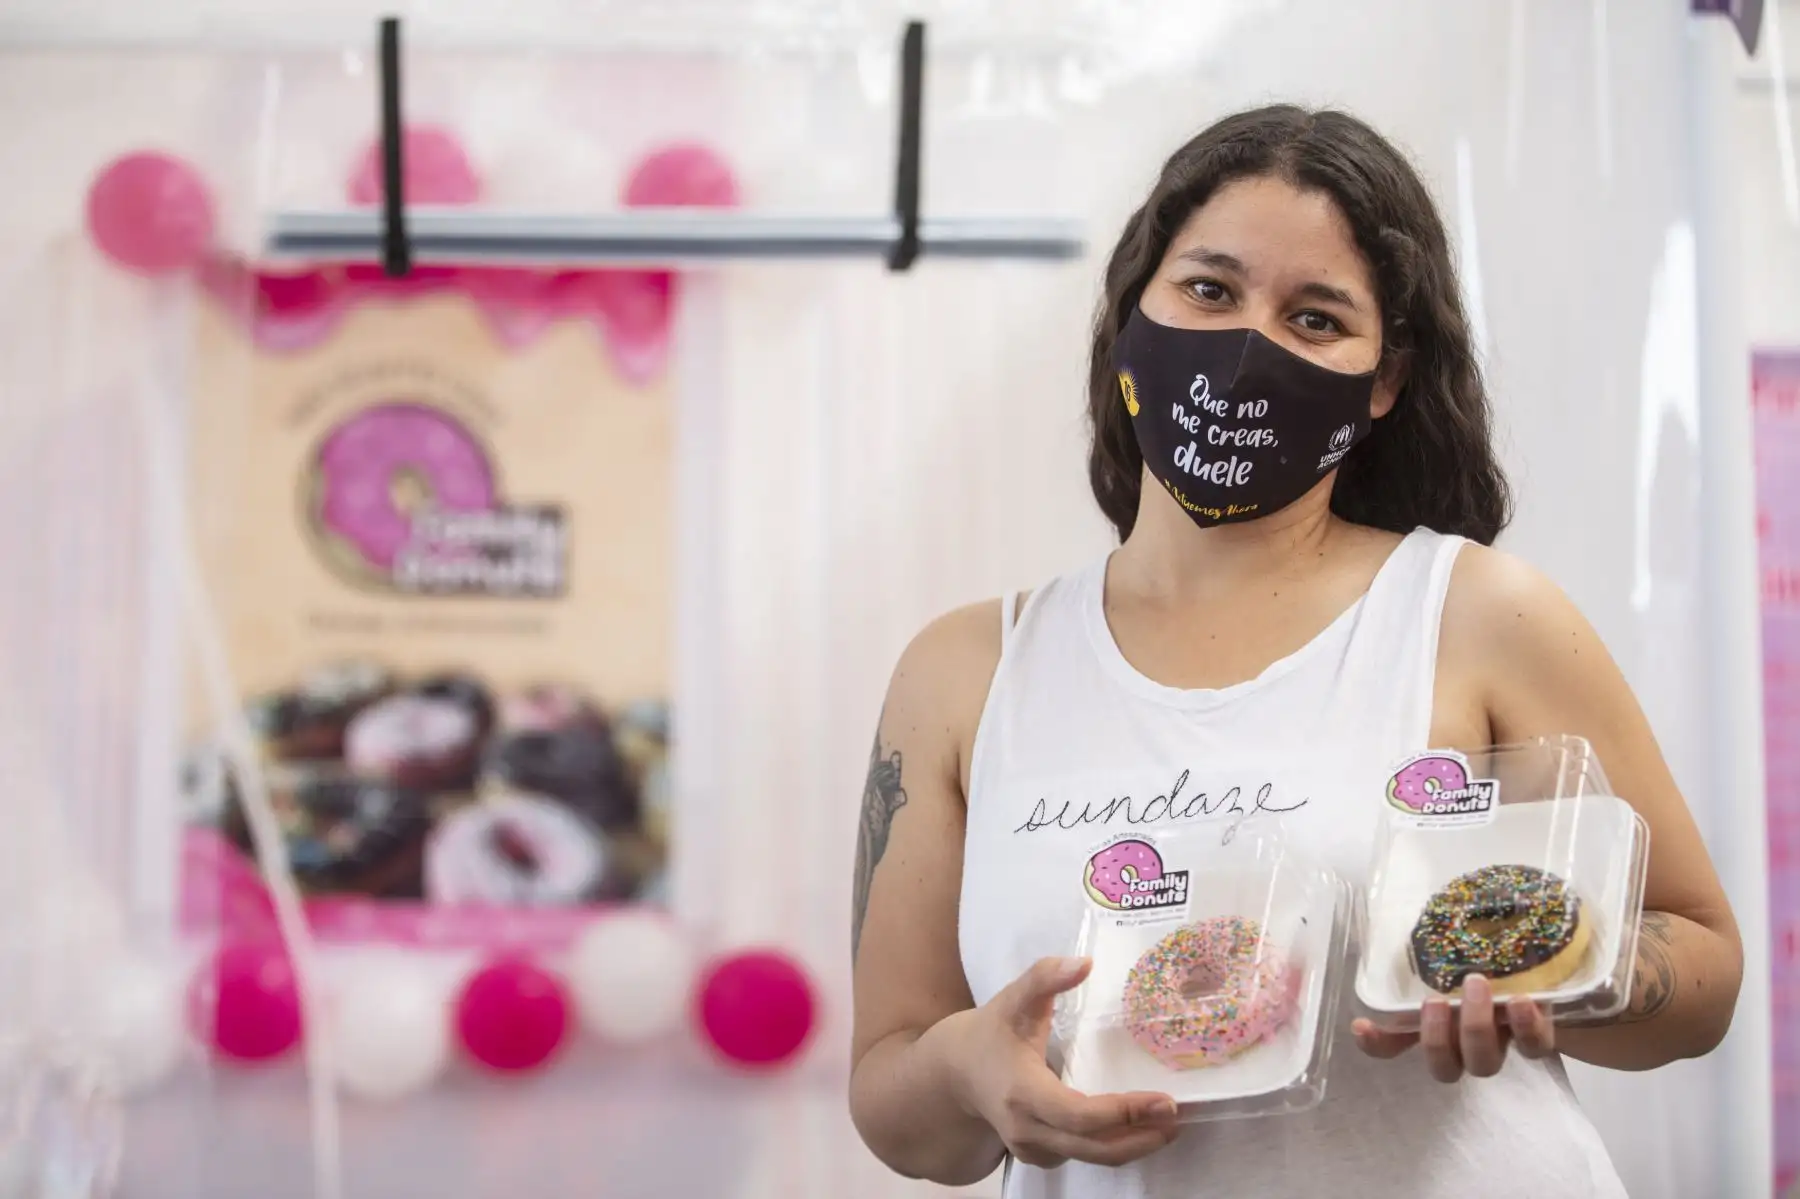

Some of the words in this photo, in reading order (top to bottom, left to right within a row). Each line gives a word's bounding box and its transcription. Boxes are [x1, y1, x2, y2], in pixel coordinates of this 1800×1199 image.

[1189, 373, 1229, 418] Que
[1236, 398, 1269, 419] no
[1172, 402, 1201, 433] me
[1207, 425, 1280, 447] creas,
[1173, 440, 1253, 487] duele
[1013, 768, 1309, 847] sundaze
[1422, 798, 1490, 813] Donuts
[1432, 784, 1491, 802] Family
[1121, 889, 1186, 908] Donuts
[1129, 873, 1187, 893] Family
